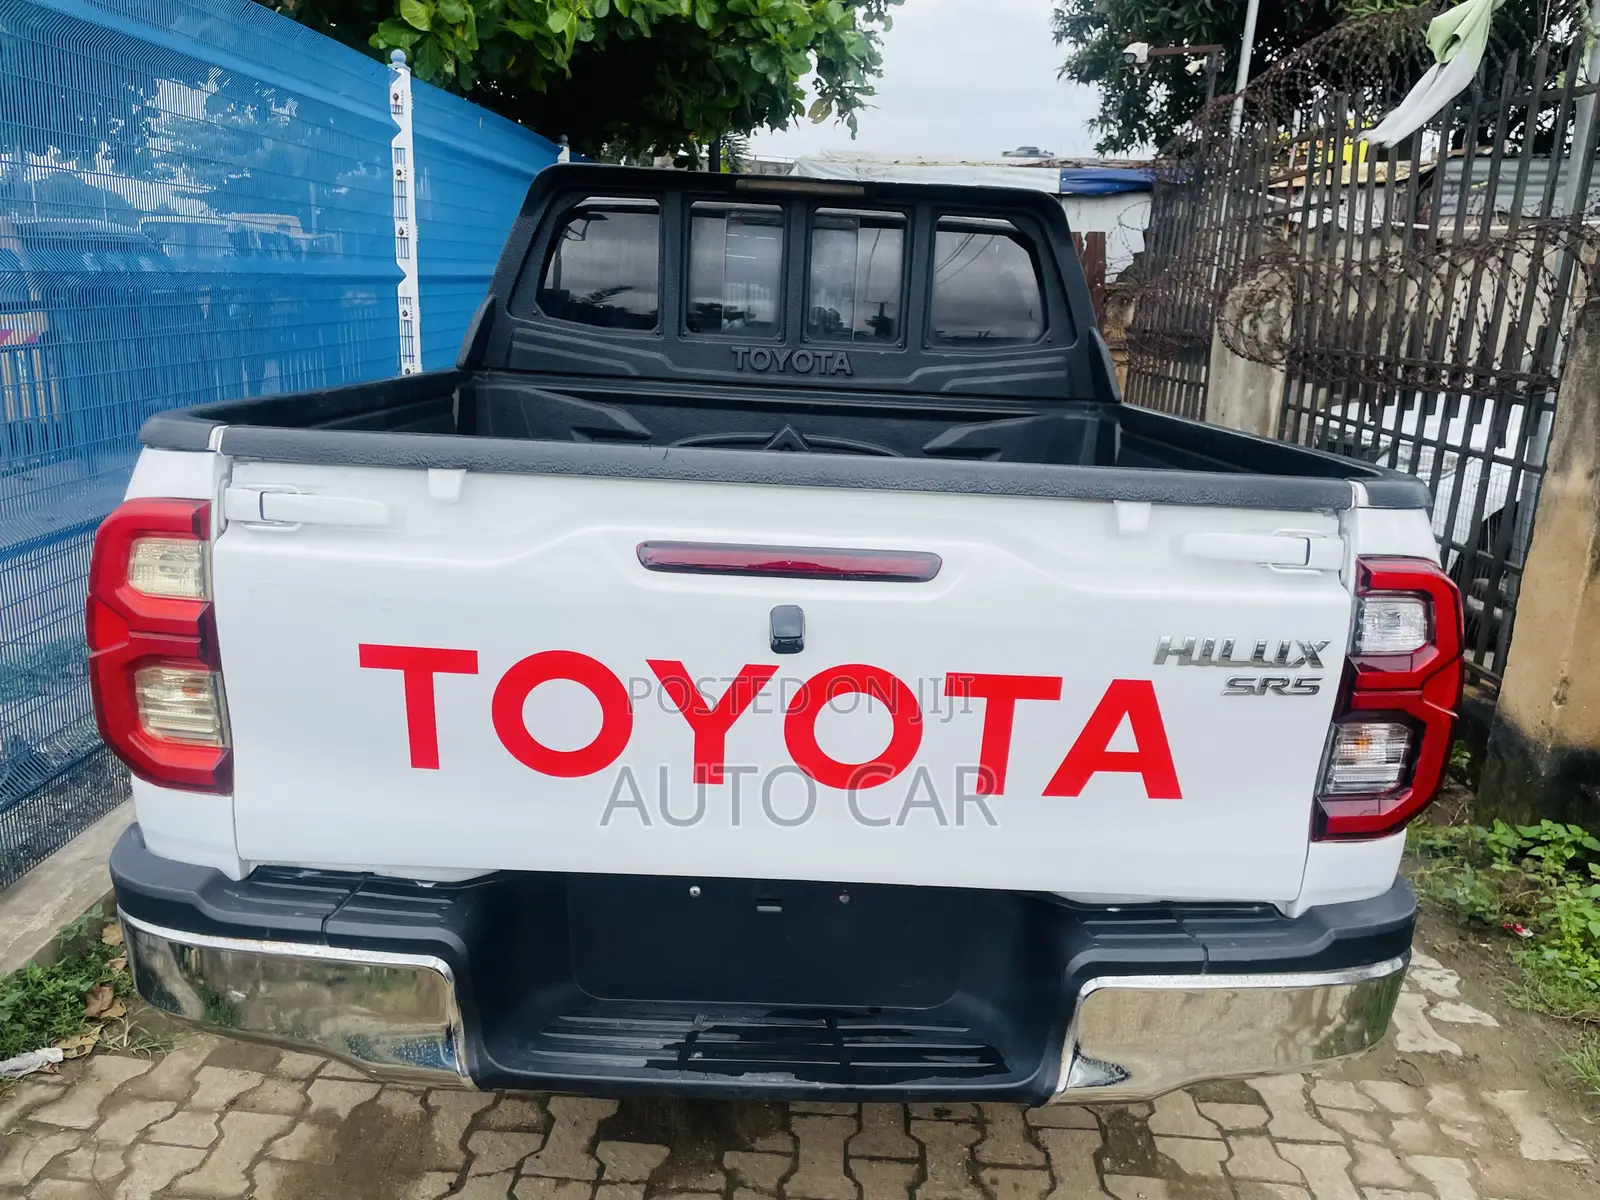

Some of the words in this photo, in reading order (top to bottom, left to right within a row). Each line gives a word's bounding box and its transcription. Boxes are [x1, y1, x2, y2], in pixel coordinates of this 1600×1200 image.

[730, 346, 853, 376] TOYOTA
[1153, 635, 1331, 669] HILUX
[1220, 675, 1323, 696] SR5
[358, 643, 1182, 800] TOYOTA
